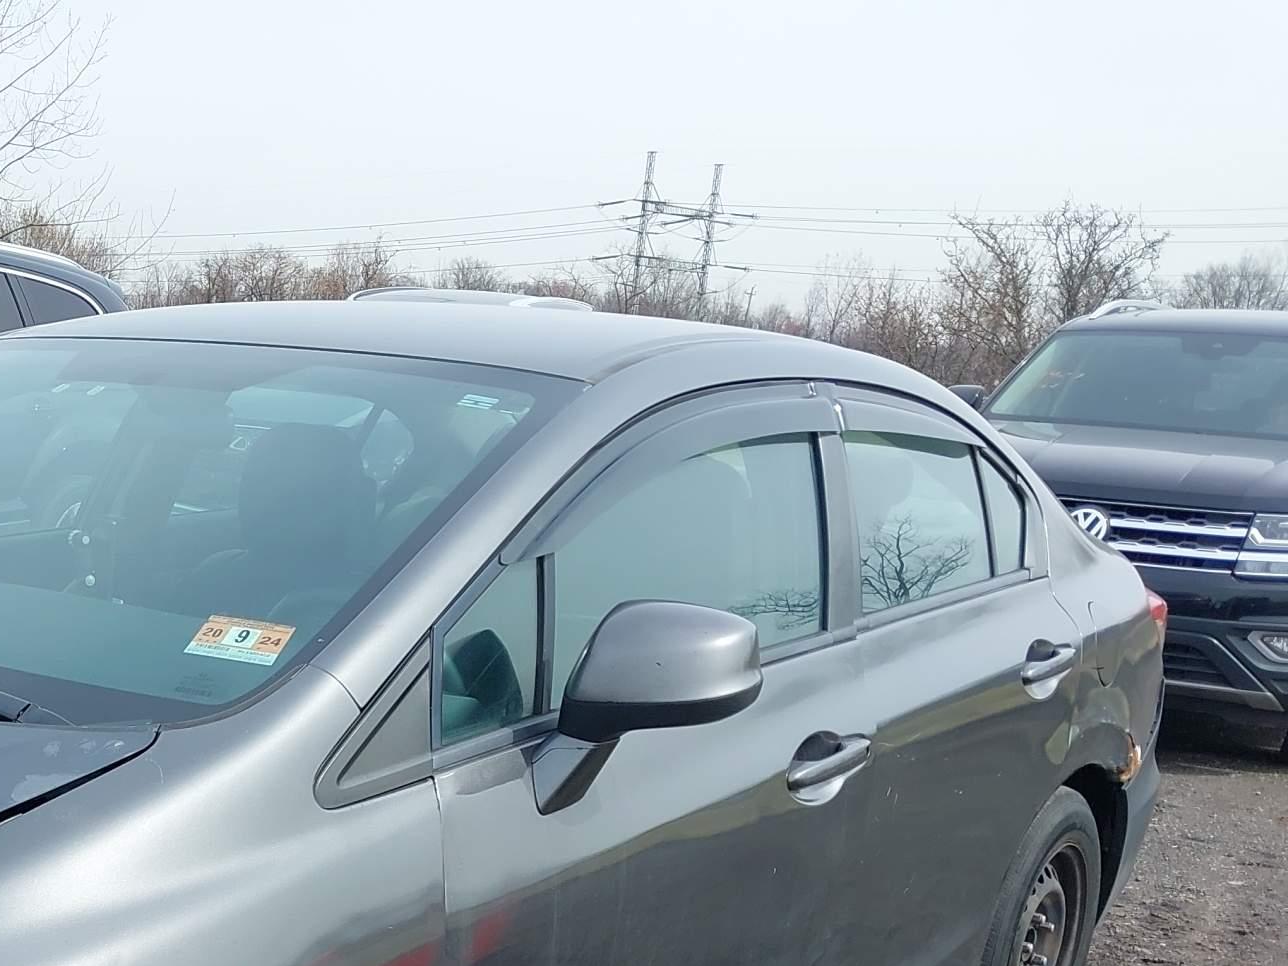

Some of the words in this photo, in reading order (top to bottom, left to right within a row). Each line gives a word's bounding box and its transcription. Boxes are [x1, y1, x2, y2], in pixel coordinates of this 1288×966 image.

[202, 627, 224, 638] 20
[234, 629, 251, 643] 9
[258, 636, 282, 647] 24
